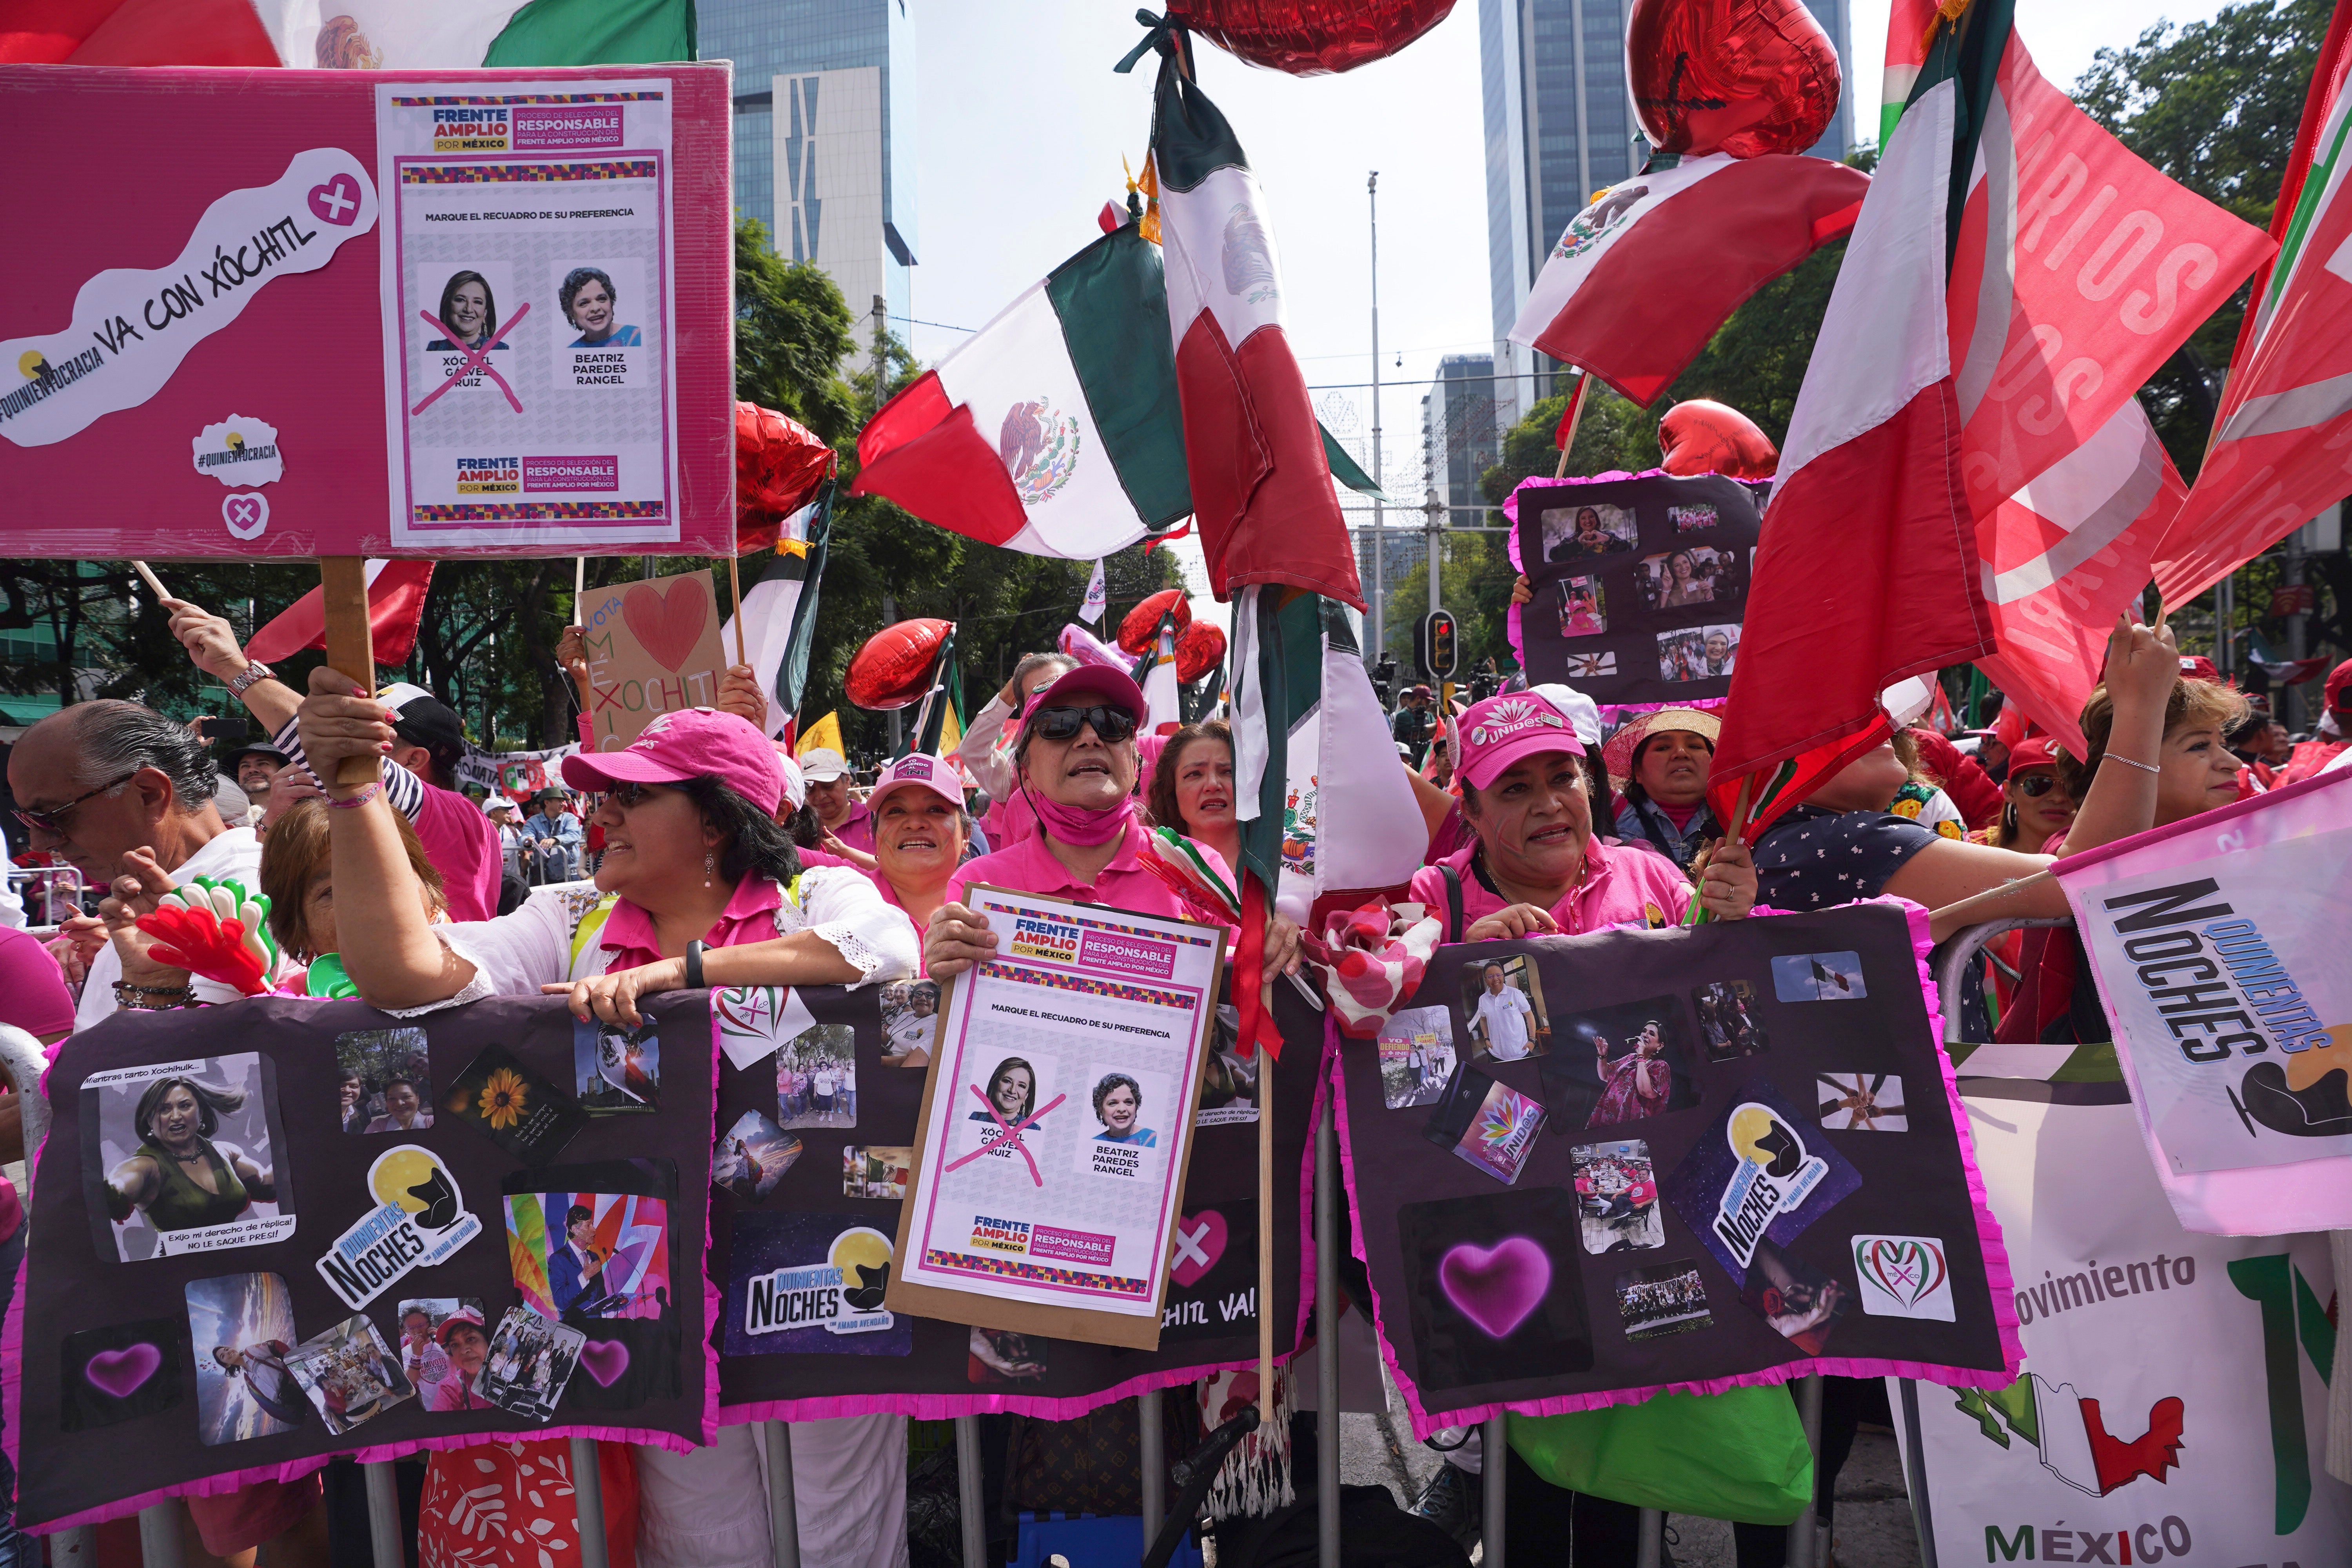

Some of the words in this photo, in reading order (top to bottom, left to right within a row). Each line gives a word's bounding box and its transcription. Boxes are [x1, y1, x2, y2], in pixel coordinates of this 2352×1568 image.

[434, 108, 507, 123] FRENTE
[563, 110, 603, 118] SELECCIÓN
[434, 123, 507, 137] AMPLIO
[517, 118, 619, 131] RESPONSABLE
[548, 128, 603, 137] CONSTRUCCIÓN
[437, 141, 459, 149] POR
[462, 138, 505, 148] MÉXICO
[591, 134, 619, 143] MÉXICO
[425, 212, 468, 222] MARQUE
[470, 212, 481, 221] EL
[483, 211, 537, 220] RECUADRO
[539, 211, 552, 219] DE
[554, 211, 567, 219] SU
[570, 208, 634, 219] PREFERENCIA
[93, 315, 144, 355] VA
[144, 274, 204, 330] CON
[201, 215, 317, 298] XÓCHITL
[575, 354, 624, 363] BEATRIZ
[573, 364, 627, 374] PAREDES
[455, 378, 481, 387] RUIZ
[576, 375, 624, 385] RANGEL
[198, 444, 277, 468] #QUINIENTOCRACIA
[457, 457, 518, 470] FRENTE
[457, 470, 519, 482] AMPLIO
[526, 466, 614, 476] RESPONSABLE
[482, 481, 517, 492] MÉXICO
[582, 597, 622, 633] VOTA
[1488, 716, 1544, 744] UNID@S
[897, 762, 929, 771] DEFIENDO
[505, 768, 535, 784] PRI
[1015, 919, 1079, 940] FRENTE
[1014, 931, 1077, 951] AMPLIO
[1086, 934, 1115, 944] PROCESO
[1126, 940, 1159, 951] SELECCIÓN
[1014, 945, 1033, 955] POR
[1035, 949, 1072, 961] MÉXICO
[1084, 942, 1172, 964] RESPONSABLE
[1110, 954, 1156, 967] CONSTRUCCIÓN
[1082, 956, 1107, 965] FRENTE
[1107, 960, 1131, 969] AMPLIO
[1145, 965, 1169, 975] MÉXICO
[2102, 877, 2269, 1065] NOCHES
[2201, 918, 2333, 1054] QUINIENTAS
[991, 1004, 1028, 1016] MARQUE
[1041, 1011, 1088, 1025] RECUADRO
[1114, 1023, 1171, 1039] PREFERENCIA
[84, 1074, 122, 1085] Mientras
[125, 1071, 149, 1080] tanto
[151, 1063, 200, 1076] Xochihulk...
[1237, 1108, 1259, 1116] réplica!
[1506, 1109, 1537, 1158] UNID@S
[988, 1149, 1011, 1158] RUIZ
[1096, 1146, 1139, 1158] BEATRIZ
[1093, 1155, 1140, 1168] PAREDES
[1094, 1165, 1135, 1177] RANGEL
[1725, 1156, 1759, 1218] QUINIENTAS
[1787, 1185, 1803, 1205] AMADO
[1800, 1162, 1823, 1189] AVENDAÑO
[974, 1216, 1030, 1233] FRENTE
[1717, 1174, 1780, 1262] NOCHES
[205, 1226, 243, 1238] derecho
[260, 1218, 292, 1230] réplica!
[339, 1201, 408, 1261] QUINIENTAS
[972, 1227, 1028, 1243] AMPLIO
[1036, 1229, 1062, 1237] PROCESO
[1071, 1233, 1100, 1243] SELECCIÓN
[188, 1241, 200, 1250] NO
[216, 1237, 246, 1246] SAQUE
[249, 1230, 278, 1242] PRESI!
[432, 1240, 452, 1260] AMADO
[451, 1220, 477, 1246] AVENDAÑO
[973, 1239, 989, 1247] POR
[991, 1241, 1024, 1252] MÉXICO
[1034, 1235, 1111, 1252] RESPONSABLE
[1054, 1250, 1076, 1259] AMPLIO
[1057, 1245, 1097, 1257] CONSTRUCCIÓN
[322, 1222, 426, 1304] NOCHES
[776, 1267, 843, 1293] QUINIENTAS
[2015, 1254, 2195, 1326] ovimiento
[751, 1279, 839, 1330] NOCHES
[1160, 1299, 1208, 1330] HITL
[1218, 1287, 1256, 1321] VA!
[838, 1320, 858, 1329] AMADO
[859, 1315, 889, 1327] AVENDAÑO
[421, 1357, 446, 1368] #MIVOTO
[421, 1363, 448, 1375] NOSETOCA
[1984, 1514, 2192, 1566] MÉXICO
